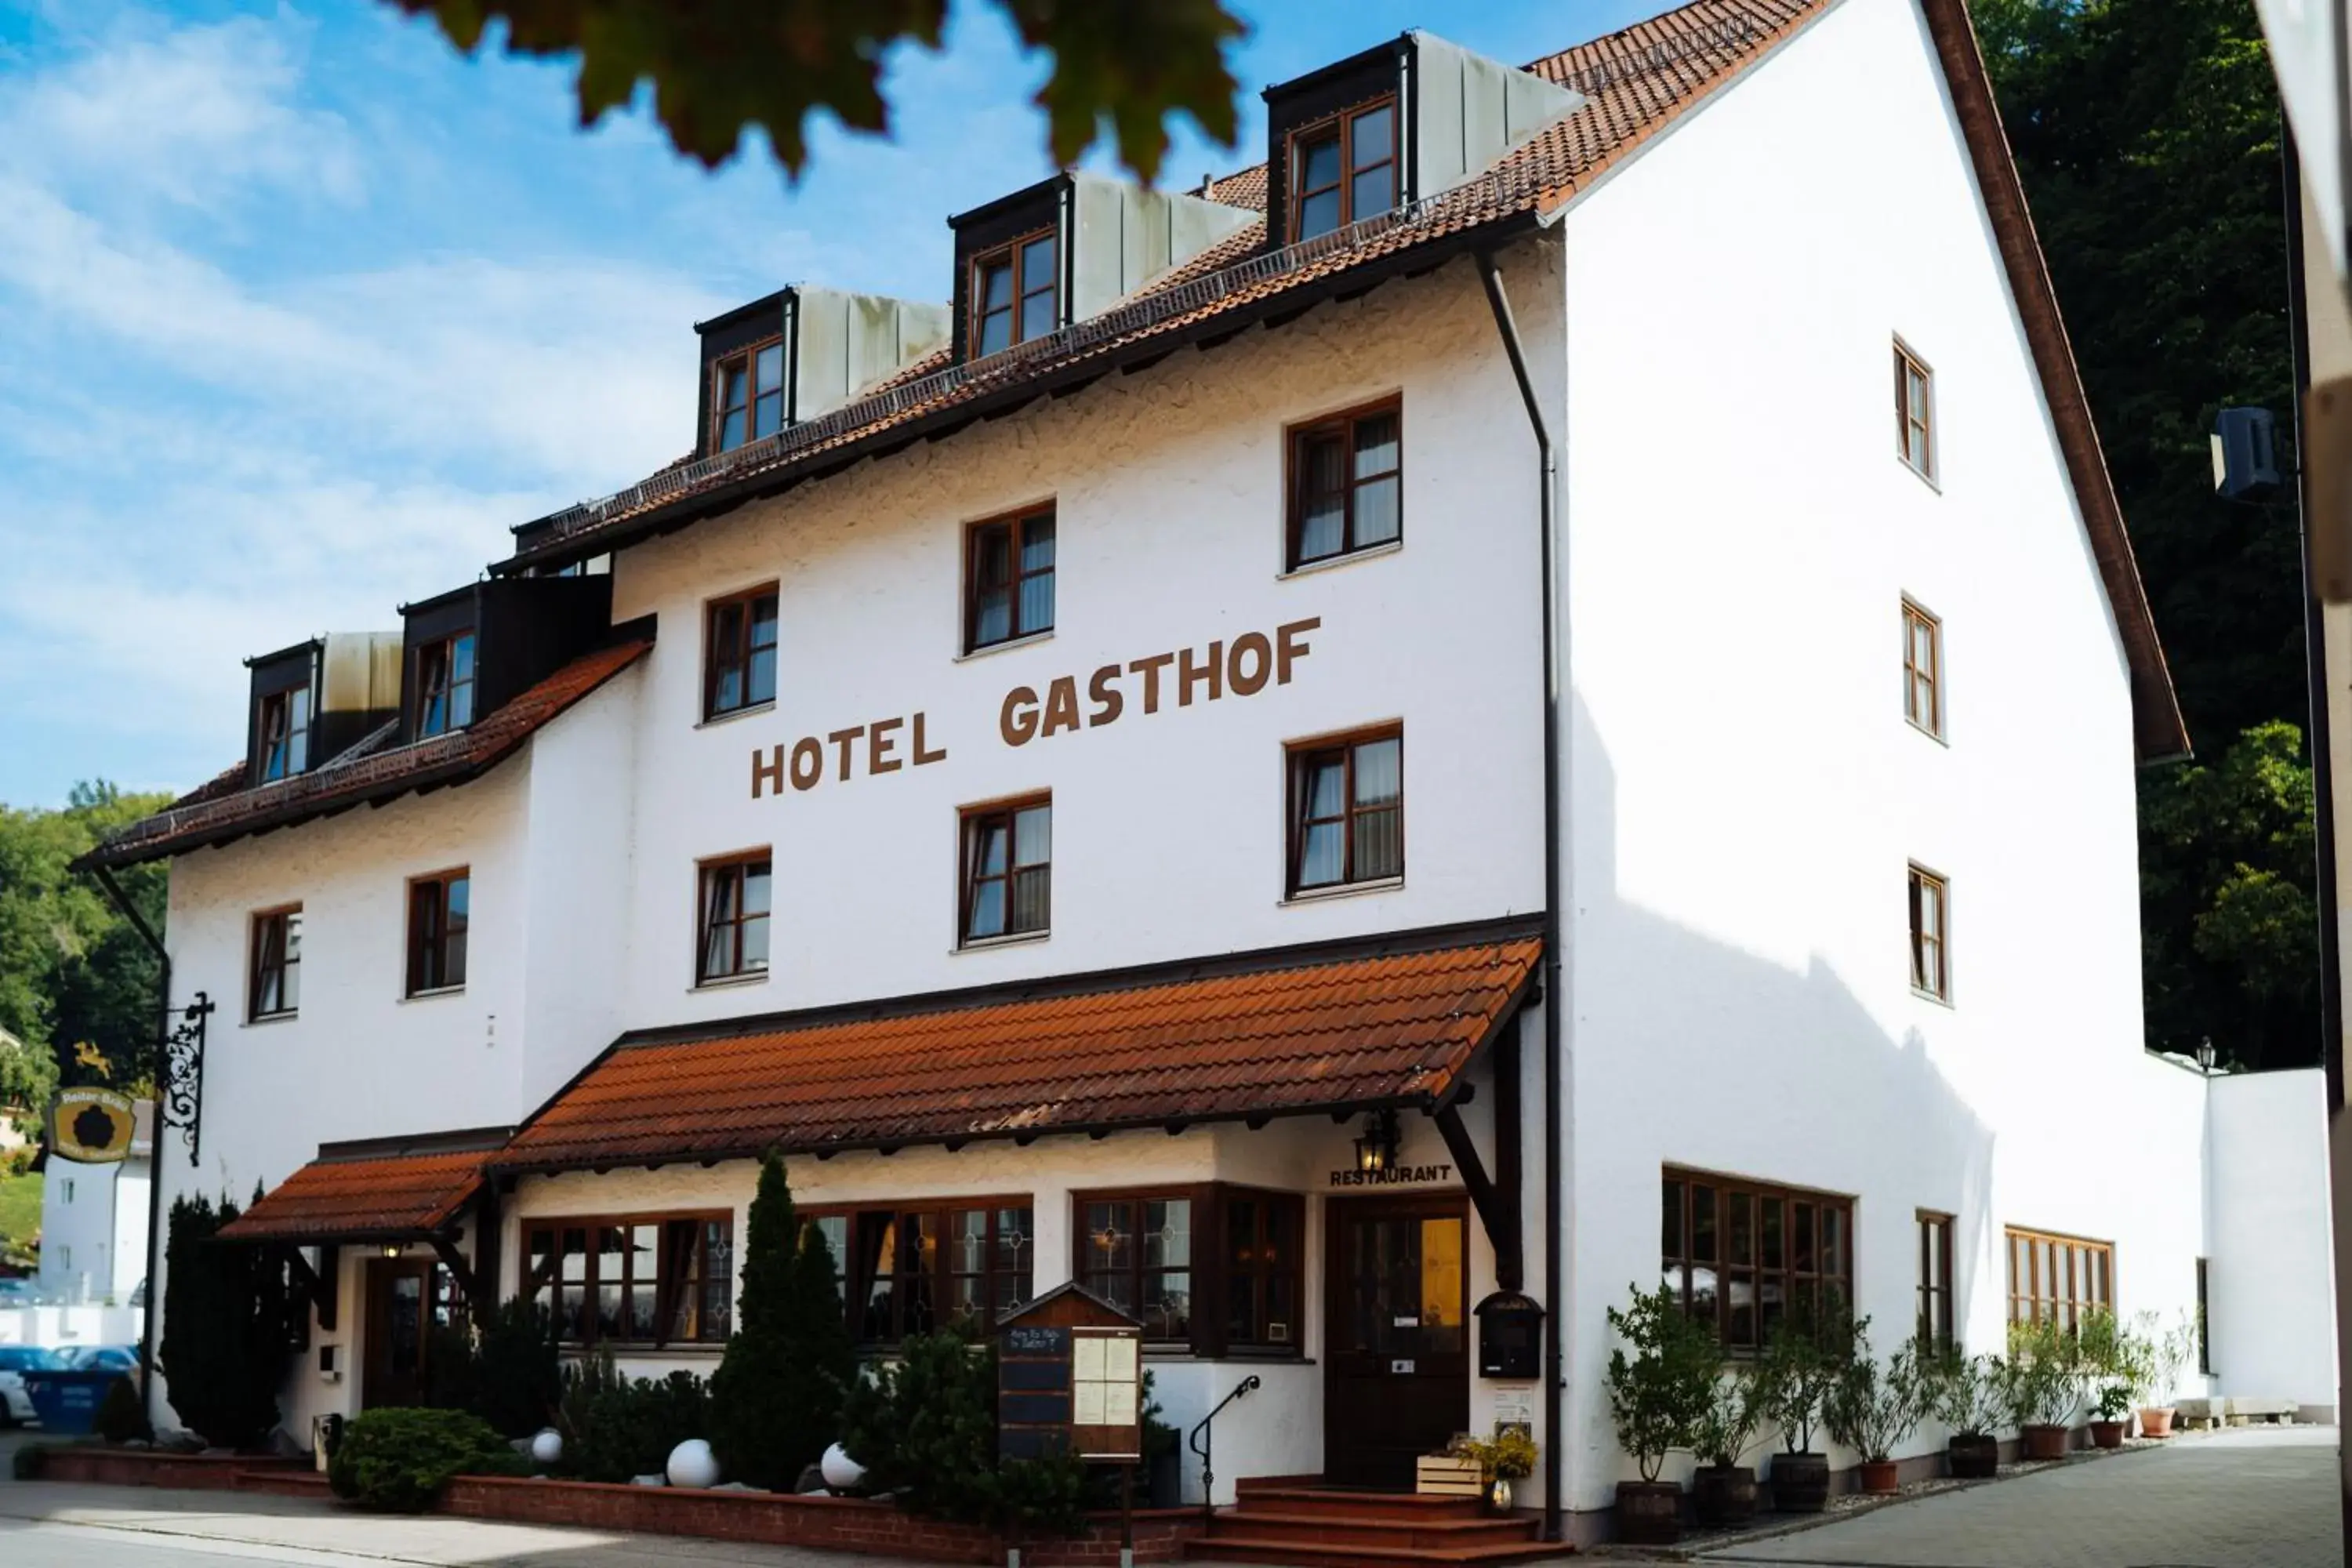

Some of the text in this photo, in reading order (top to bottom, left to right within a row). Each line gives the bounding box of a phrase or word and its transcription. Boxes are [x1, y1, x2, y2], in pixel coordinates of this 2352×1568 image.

[751, 616, 1321, 799] HOTEL GASTHOF
[1330, 1165, 1450, 1186] RESTAURANT
